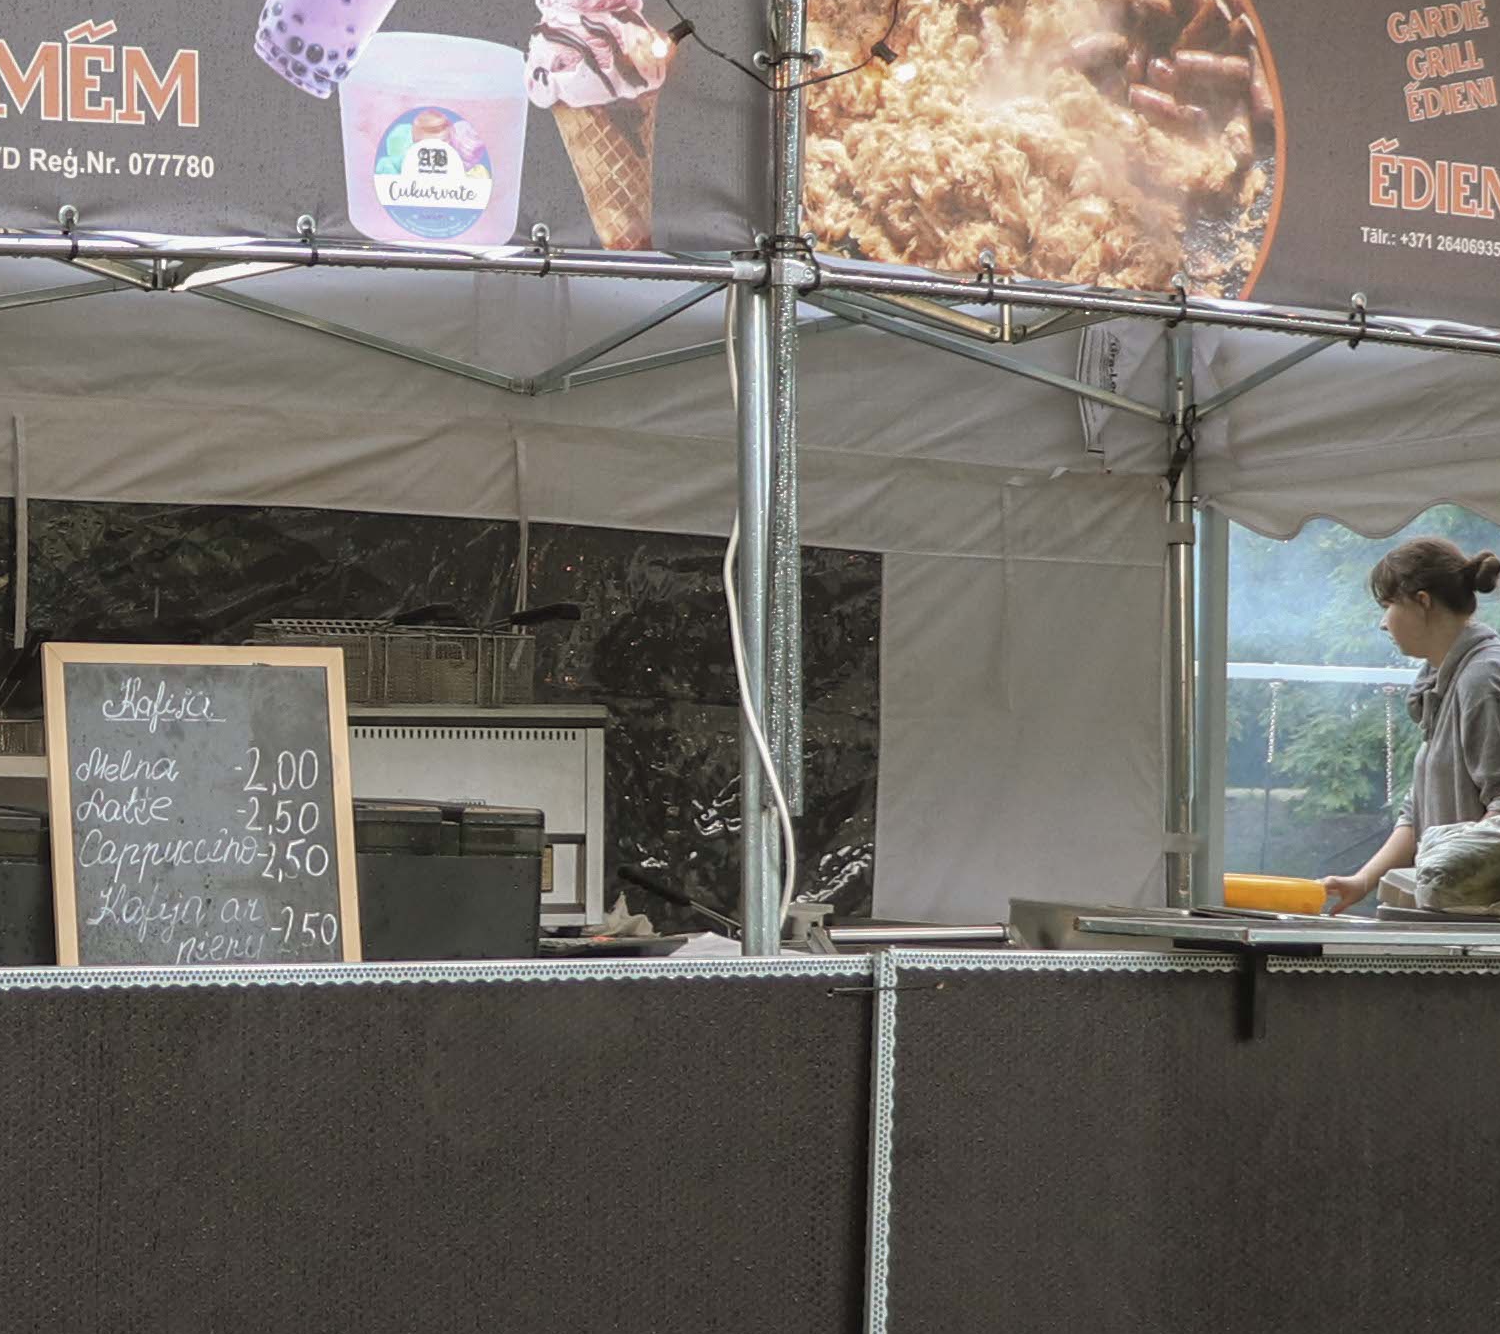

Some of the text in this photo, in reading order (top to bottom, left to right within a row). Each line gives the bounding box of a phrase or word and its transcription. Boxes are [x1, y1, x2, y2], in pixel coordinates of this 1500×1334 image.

[1406, 40, 1485, 80] GRILL
[1404, 76, 1498, 122] ĒDIENI
[129, 153, 215, 178] 077780
[388, 180, 478, 202] Cukurvate
[1360, 226, 1396, 246] Tālr.:
[1399, 231, 1433, 250] +371
[75, 747, 180, 782] Melna
[76, 785, 174, 825] Latte
[79, 828, 259, 883] Cappuccino
[220, 897, 264, 923] ar
